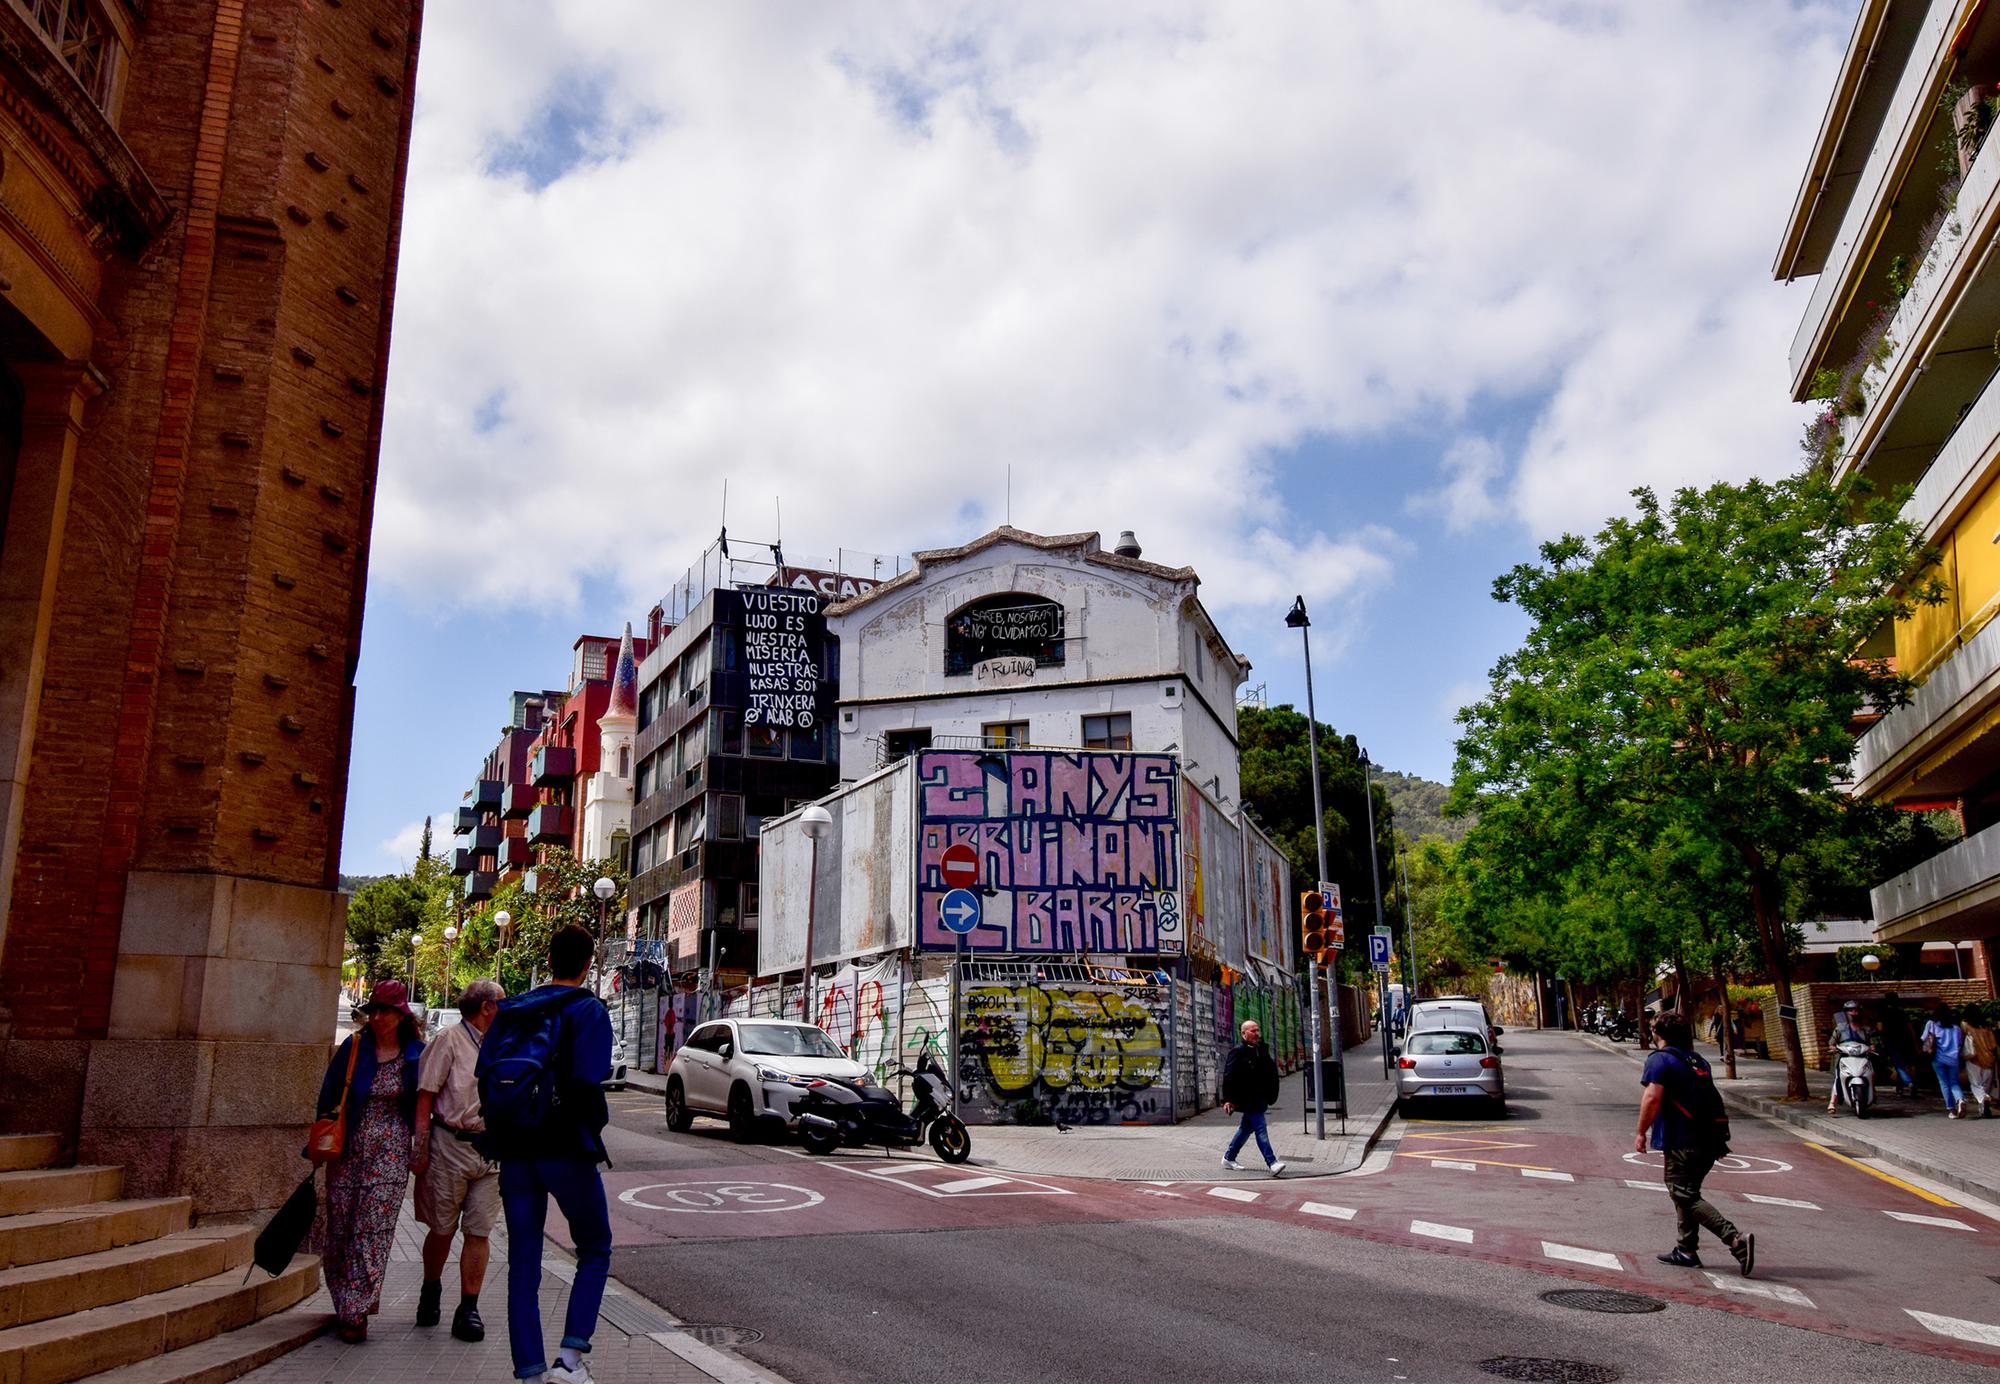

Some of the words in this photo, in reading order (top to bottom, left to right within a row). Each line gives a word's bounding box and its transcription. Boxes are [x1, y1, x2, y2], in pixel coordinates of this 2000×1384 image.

[743, 593, 818, 614] VUESTRO
[745, 614, 777, 629] LUJO
[786, 616, 805, 631] ES
[745, 632, 807, 648] NUESTRA
[991, 623, 1048, 640] OLVIDAMOS
[746, 645, 811, 663] MISERIA
[749, 662, 818, 679] NUESTRAS
[977, 663, 989, 681] LA
[750, 679, 789, 691] KASAS
[750, 694, 816, 710] TRINXERA
[766, 709, 794, 727] ACAB
[1008, 752, 1177, 820] ANYS
[1373, 938, 1385, 960] P
